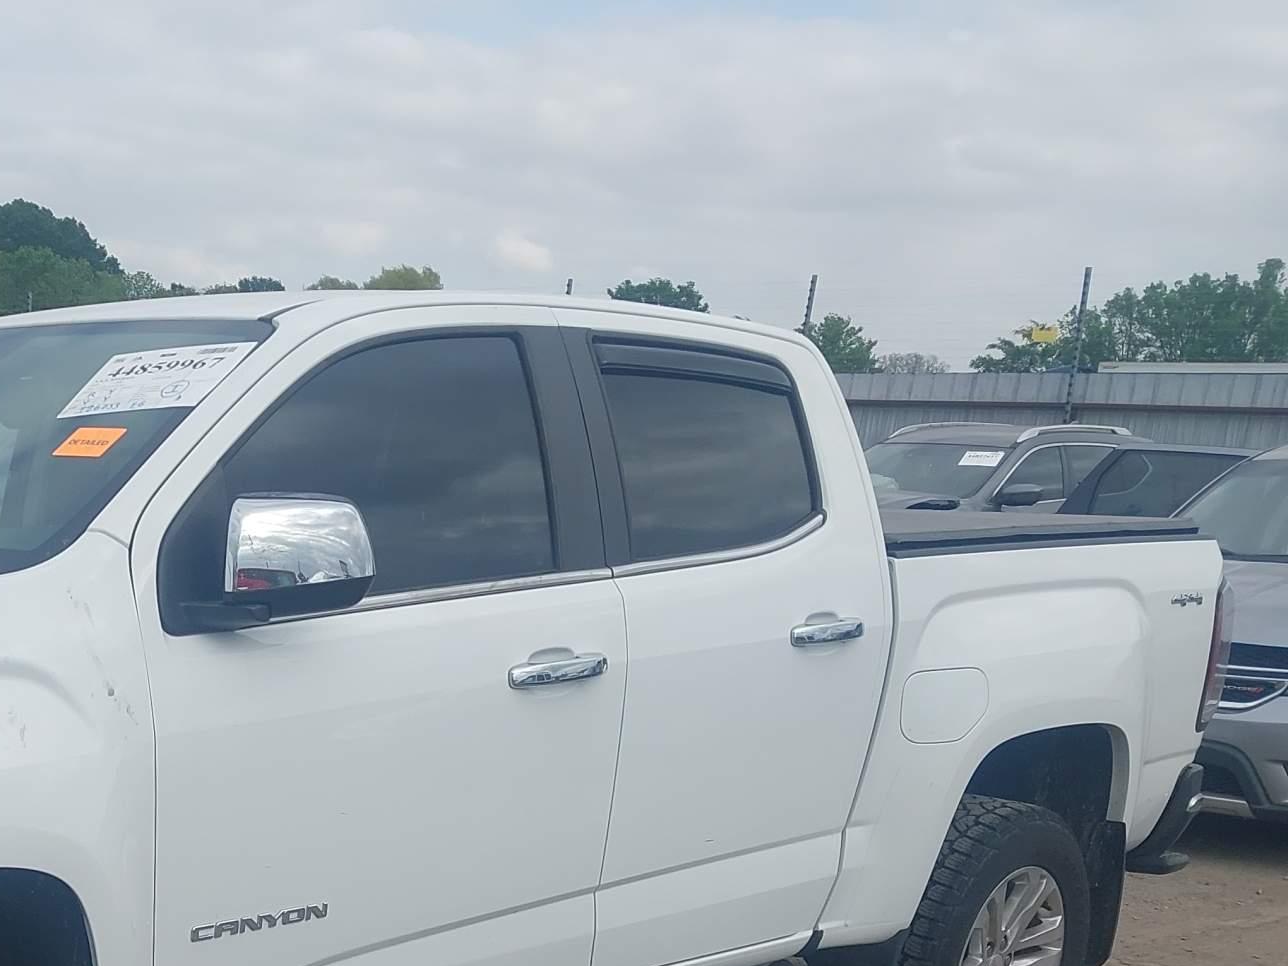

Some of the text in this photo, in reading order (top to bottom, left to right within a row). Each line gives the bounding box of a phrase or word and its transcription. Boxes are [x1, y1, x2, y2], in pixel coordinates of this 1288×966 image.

[108, 356, 225, 377] 44859967
[68, 438, 110, 447] DETAILED
[191, 903, 328, 942] CANYON
